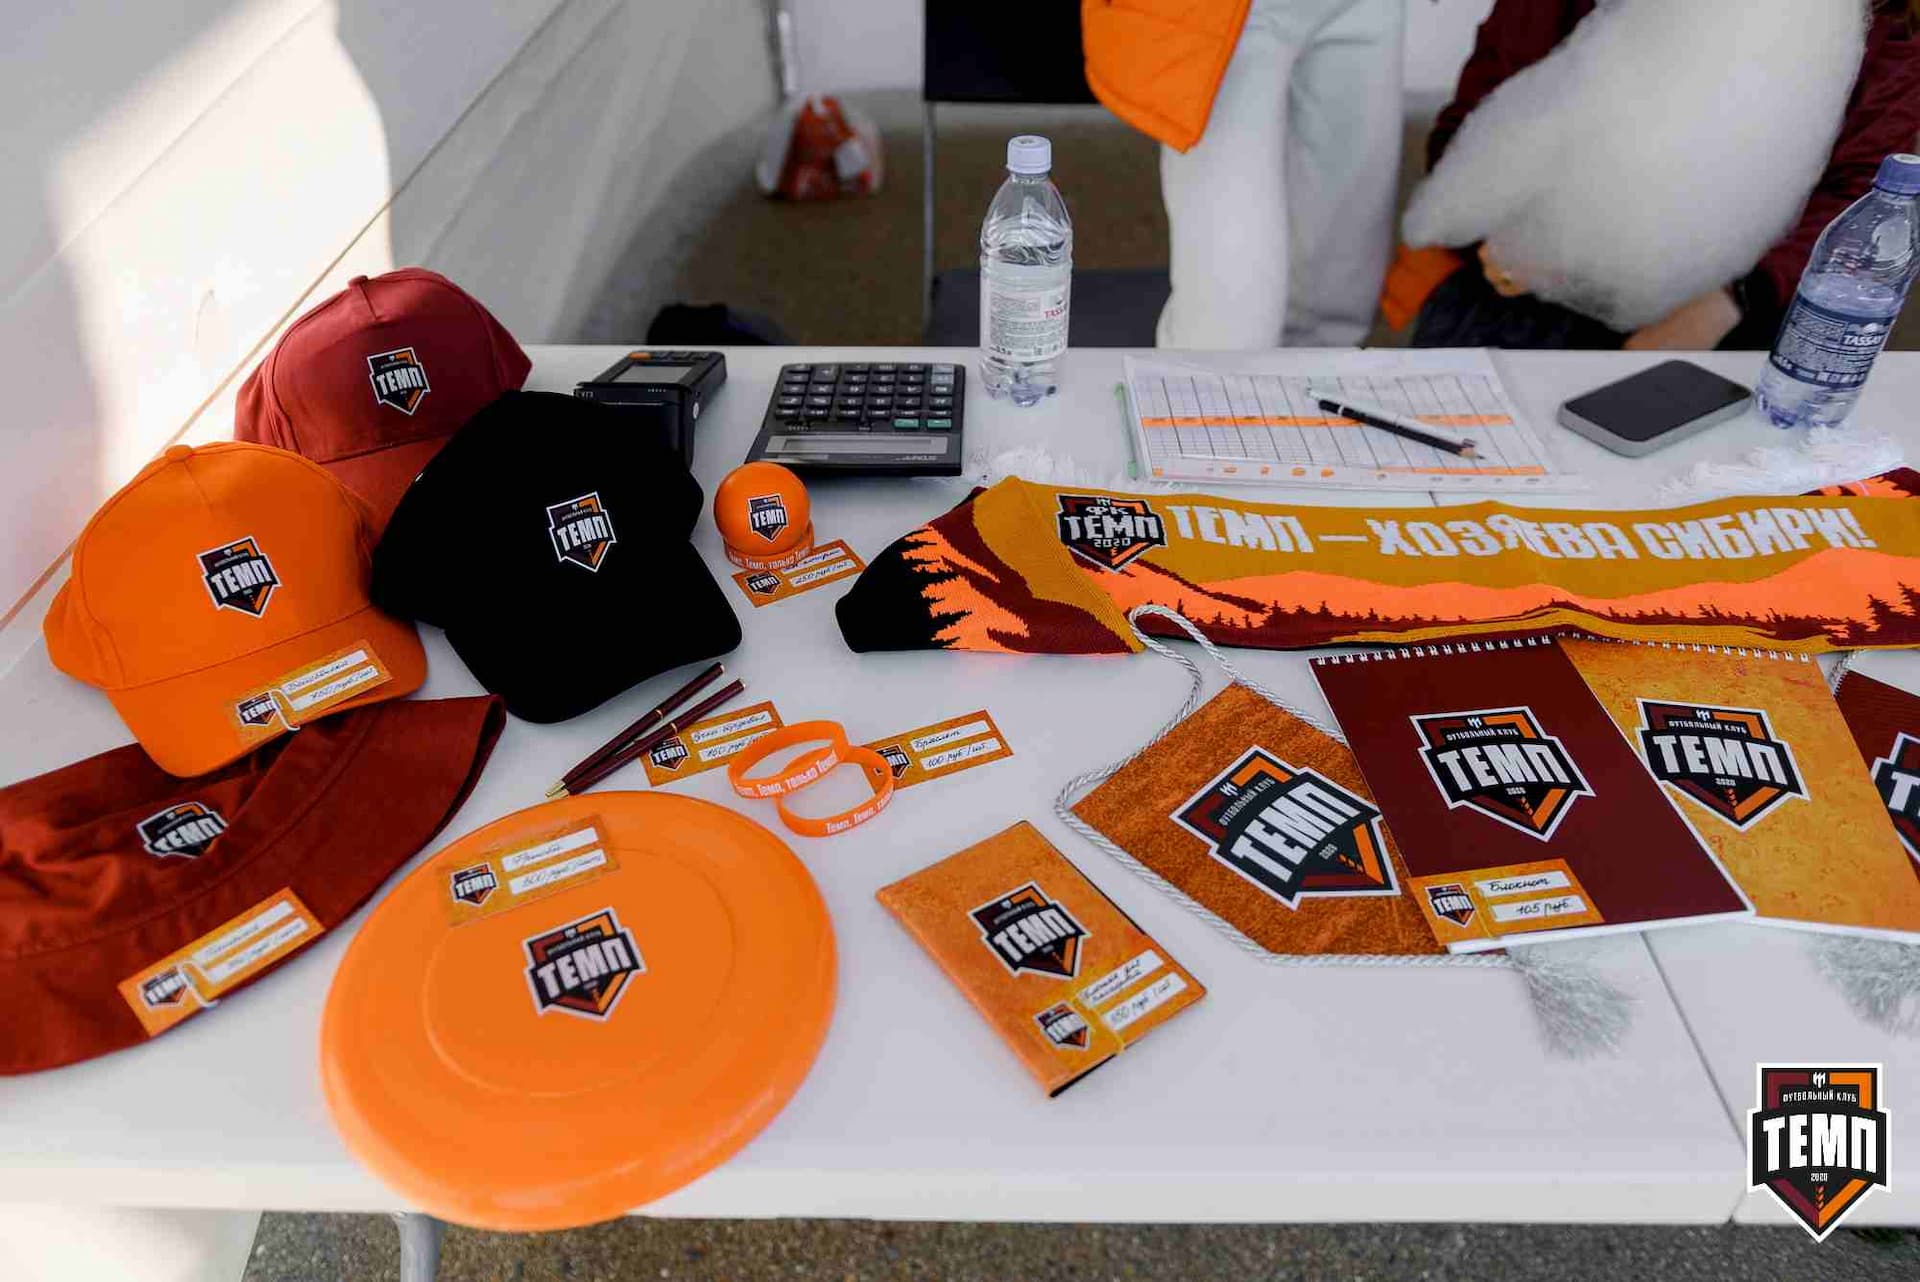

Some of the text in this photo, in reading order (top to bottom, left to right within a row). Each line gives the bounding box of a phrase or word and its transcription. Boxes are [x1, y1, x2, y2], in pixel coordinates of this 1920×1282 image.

[376, 366, 423, 396] ТЕМП
[557, 515, 608, 551] ТЕМП
[752, 508, 786, 528] ТЕМП
[1063, 515, 1159, 541] ТЕМП
[1166, 505, 1314, 553] ТЕМП
[1366, 514, 1639, 560] ХОЗЯЕВА
[1632, 507, 1878, 560] СИБИРИ!
[1093, 538, 1130, 548] 2020
[210, 559, 272, 599] ТЕМП
[749, 576, 778, 591] ТЕМП
[652, 745, 686, 764] ТЕМП
[1436, 744, 1571, 792] ТЕМП
[1652, 734, 1789, 785] ТЕМП
[153, 817, 225, 852] ТЕМП
[1230, 782, 1362, 883] ТЕМП
[455, 874, 495, 897] ТЕМП
[1432, 895, 1473, 914] ТЕМП
[993, 908, 1077, 962] ТЕМП
[537, 938, 632, 998] ТЕМП
